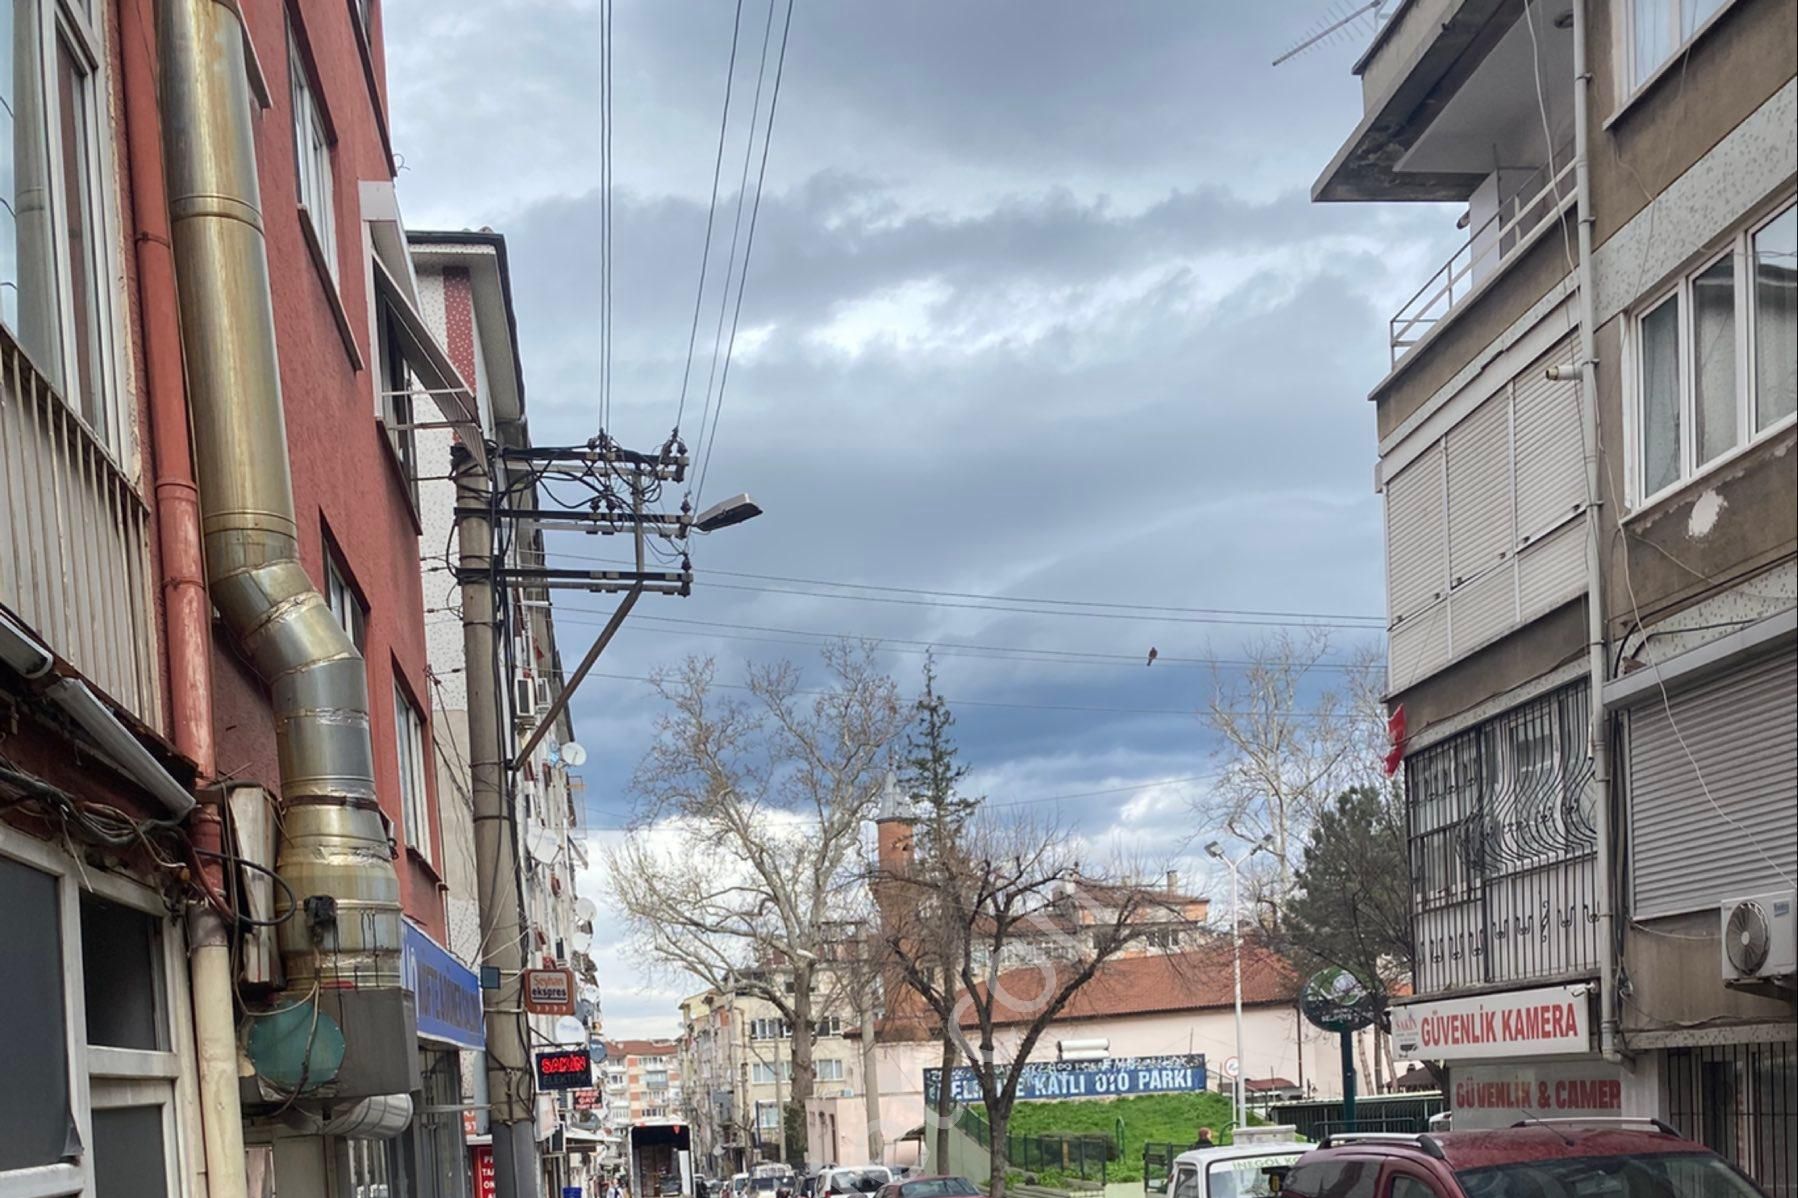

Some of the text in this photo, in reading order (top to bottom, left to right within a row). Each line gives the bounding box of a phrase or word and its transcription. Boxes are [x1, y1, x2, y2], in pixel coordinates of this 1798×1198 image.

[532, 987, 566, 998] ekspres
[1421, 1002, 1578, 1047] GÜVENLİK KAMERA
[1035, 1073, 1085, 1098] KATLI
[1138, 1069, 1192, 1090] PARKI
[1456, 1075, 1532, 1109] GÜVENLİK
[1537, 1081, 1551, 1109] &
